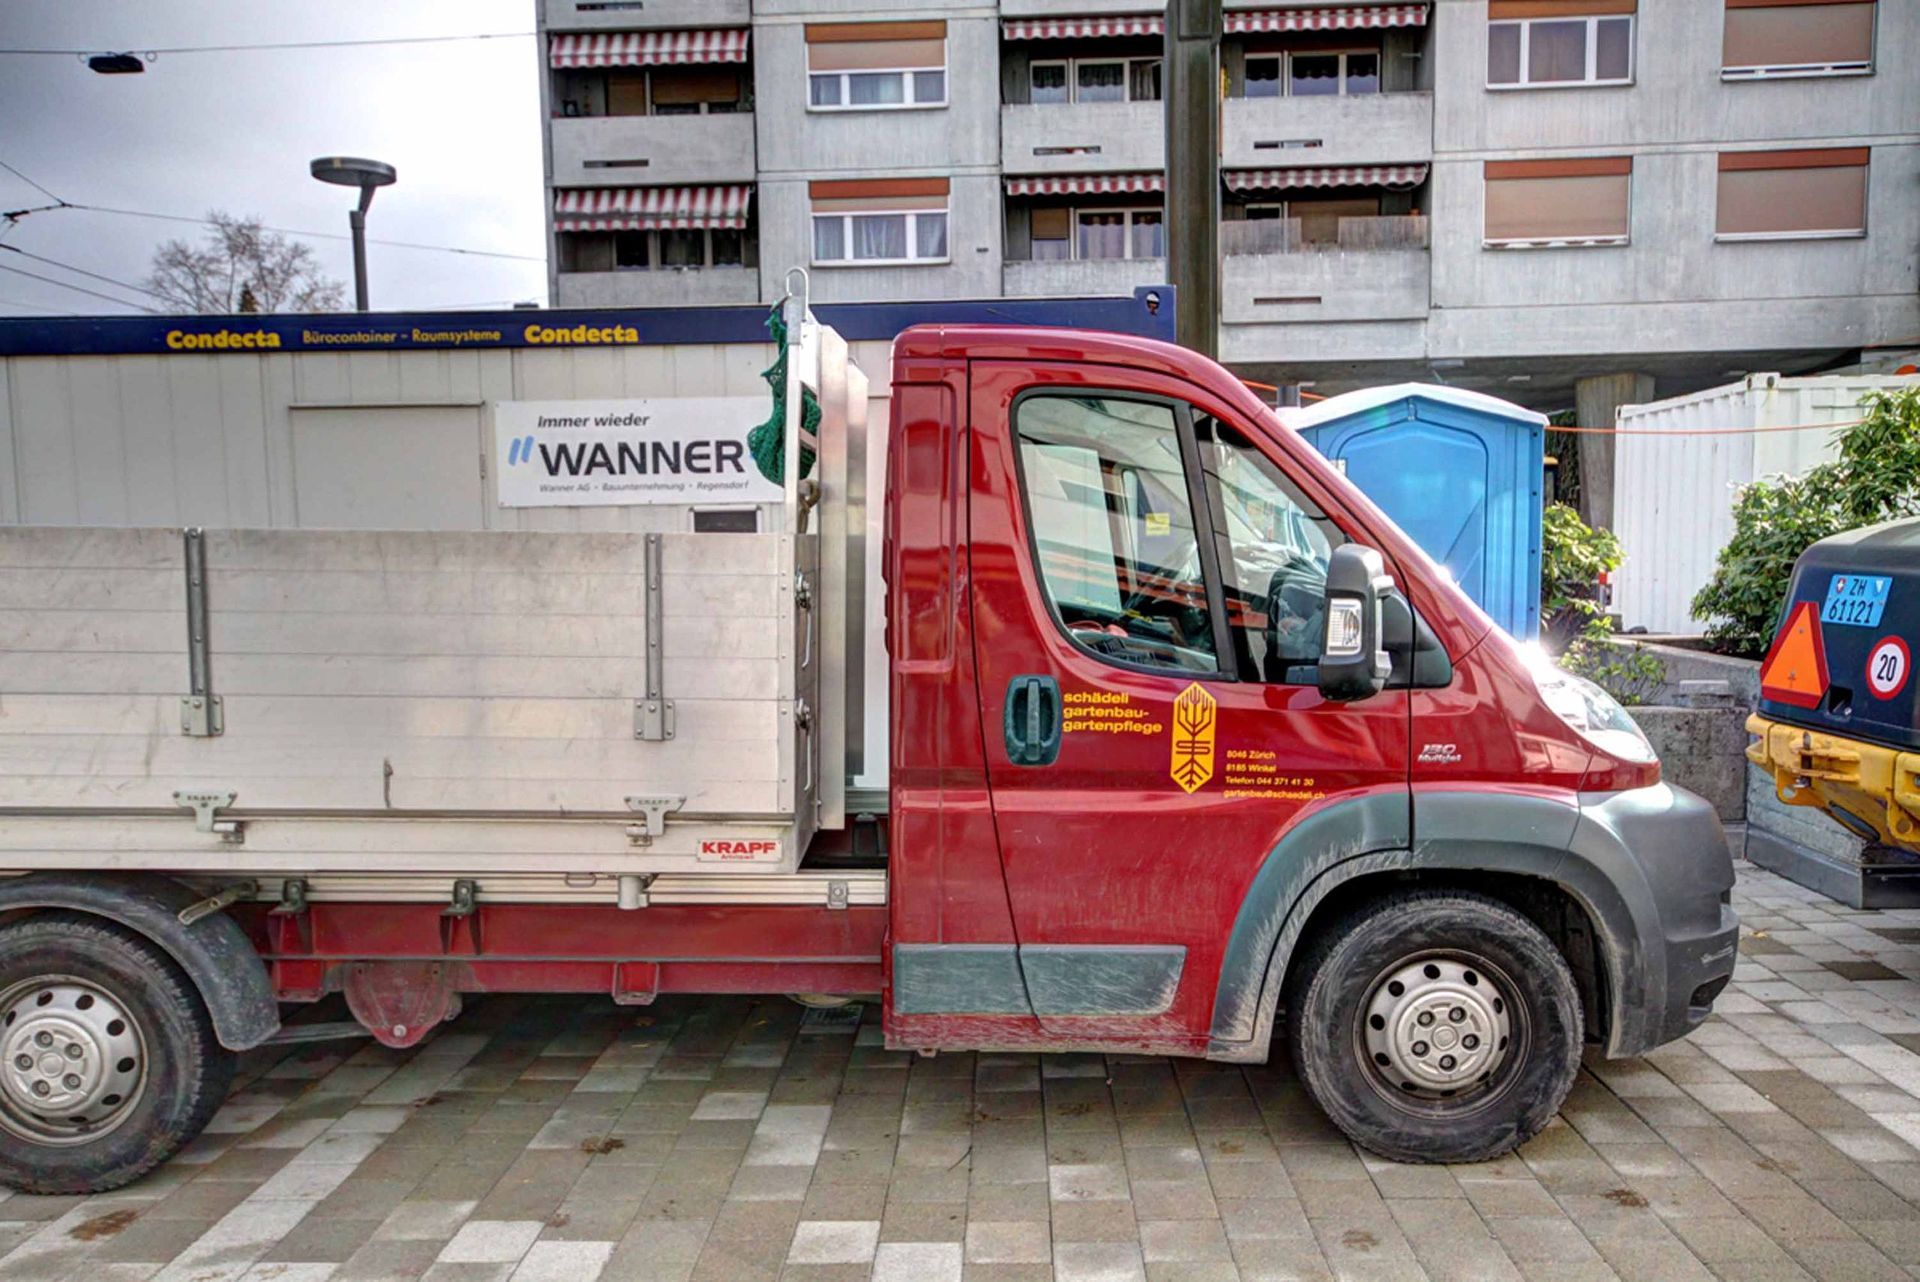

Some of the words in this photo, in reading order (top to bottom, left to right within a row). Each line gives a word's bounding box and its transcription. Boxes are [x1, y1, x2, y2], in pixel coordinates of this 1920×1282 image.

[166, 328, 281, 348] Condecta
[302, 329, 397, 344] Bürocontainer
[412, 328, 502, 345] Raumsysteme
[524, 324, 640, 344] Condecta
[537, 414, 591, 429] Immer
[594, 413, 650, 428] wieder
[538, 440, 745, 477] WANNER
[539, 483, 576, 493] Wanner
[577, 482, 591, 493] AG
[602, 482, 685, 494] Bauunternehmung
[696, 481, 750, 492] Regensdorf
[1849, 578, 1868, 597] ZH
[1828, 598, 1874, 624] 61121
[1877, 653, 1897, 682] 20
[1062, 706, 1150, 719] gartenbau-
[1062, 720, 1163, 735] gartenpflege
[1249, 749, 1276, 760] Zürich
[1225, 775, 1255, 785] Telefon
[702, 841, 777, 854] KRAPF
